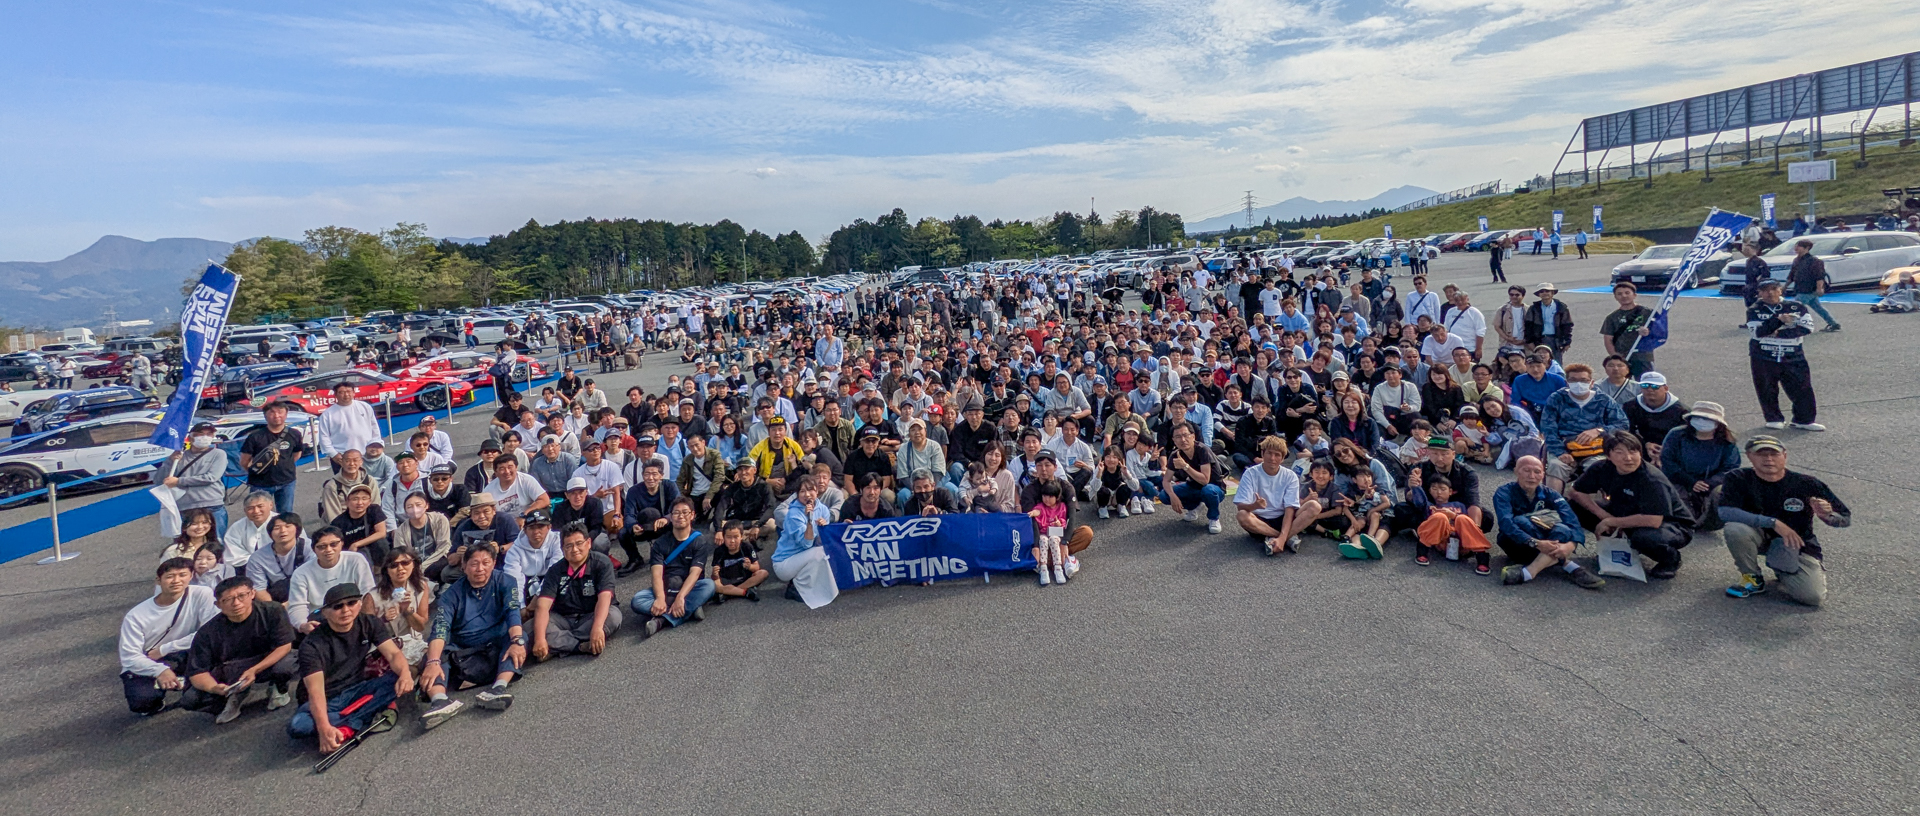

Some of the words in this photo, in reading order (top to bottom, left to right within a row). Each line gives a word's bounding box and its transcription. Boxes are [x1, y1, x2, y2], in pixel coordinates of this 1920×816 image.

[841, 517, 942, 543] RAYS
[845, 541, 900, 562] FAN
[1011, 529, 1021, 562] RAYS
[851, 556, 969, 582] MEETING
